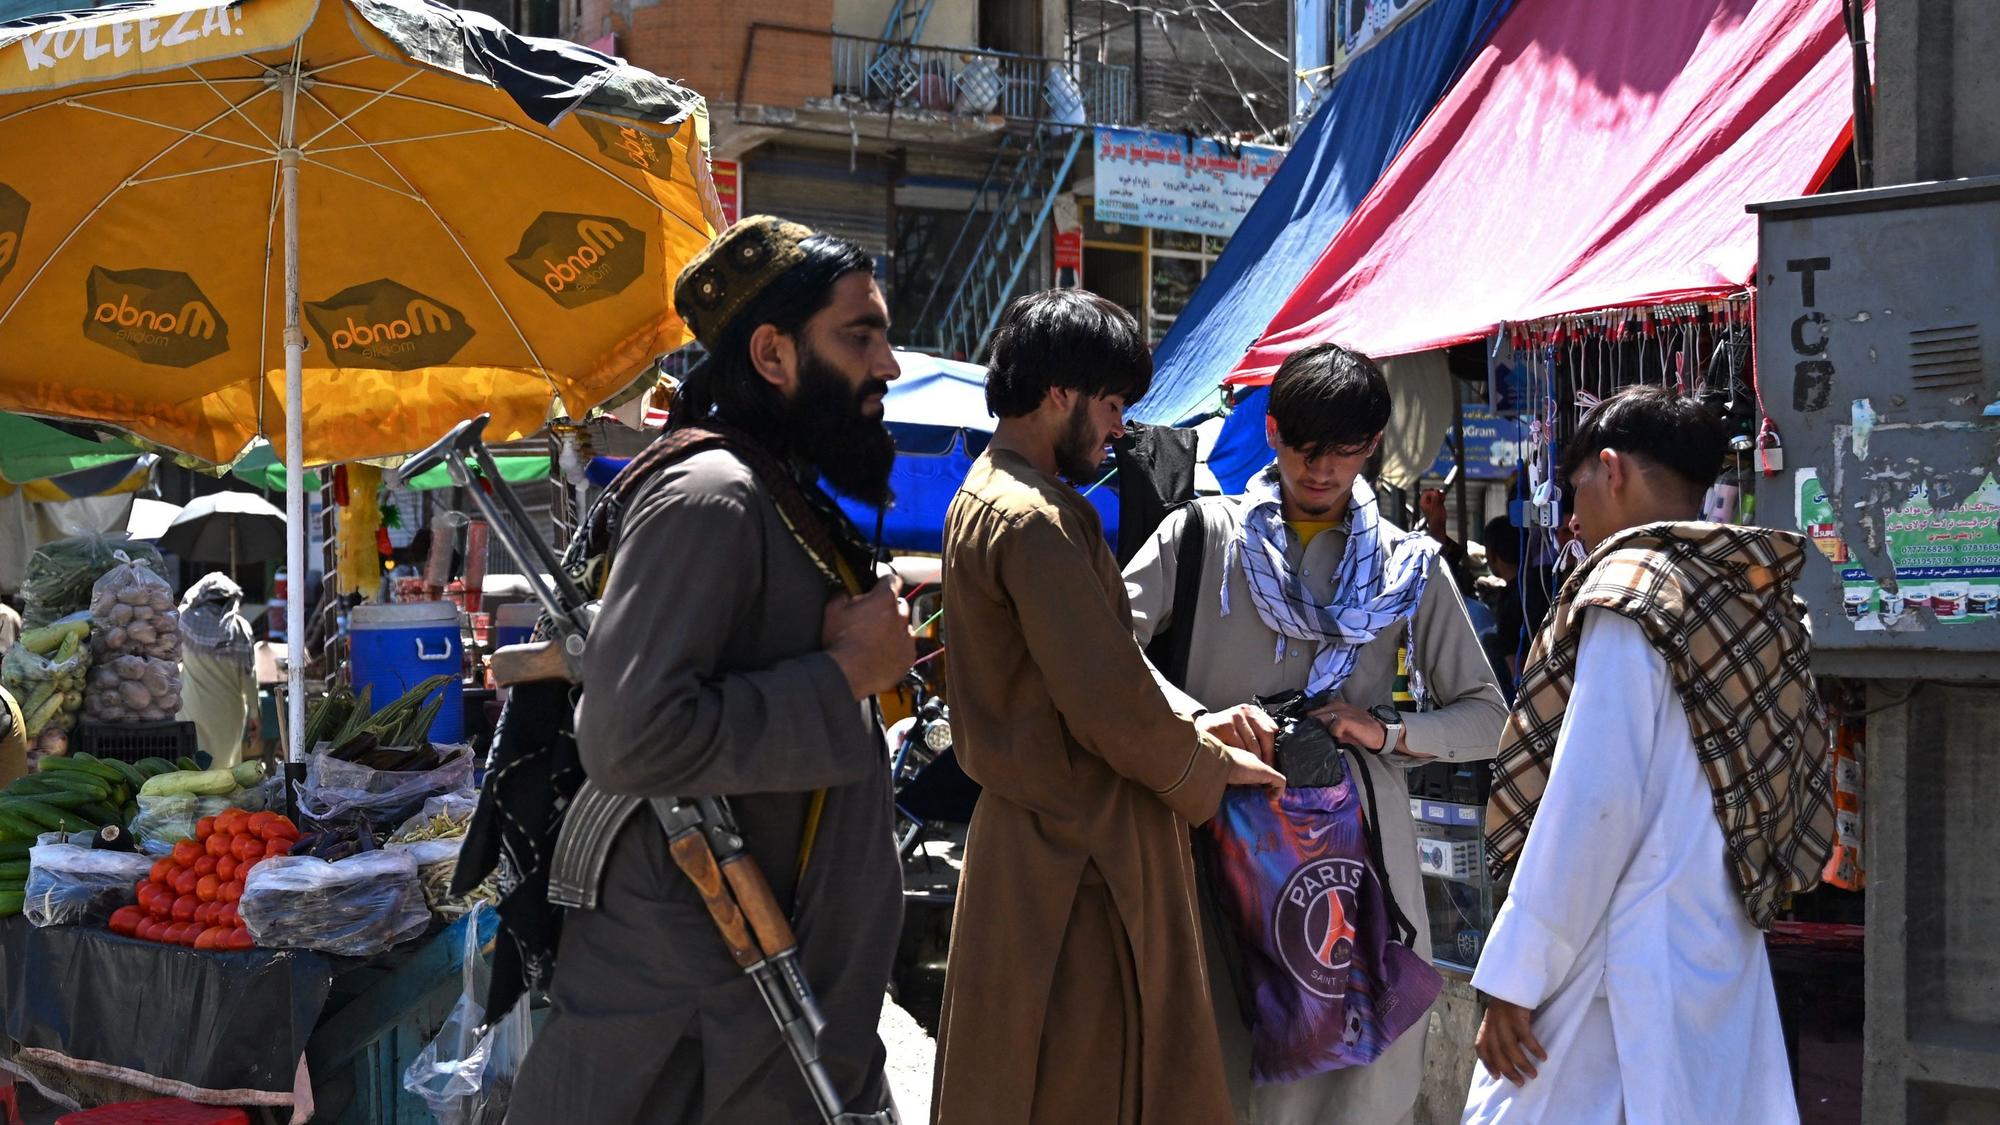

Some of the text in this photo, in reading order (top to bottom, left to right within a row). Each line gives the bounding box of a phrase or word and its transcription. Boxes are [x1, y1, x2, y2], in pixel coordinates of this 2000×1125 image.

[1901, 543, 2000, 553] 0777768259 0781669
[1962, 556, 2000, 565] 0792902
[1289, 865, 1363, 908] PARIS
[1310, 969, 1337, 986] SAINT
